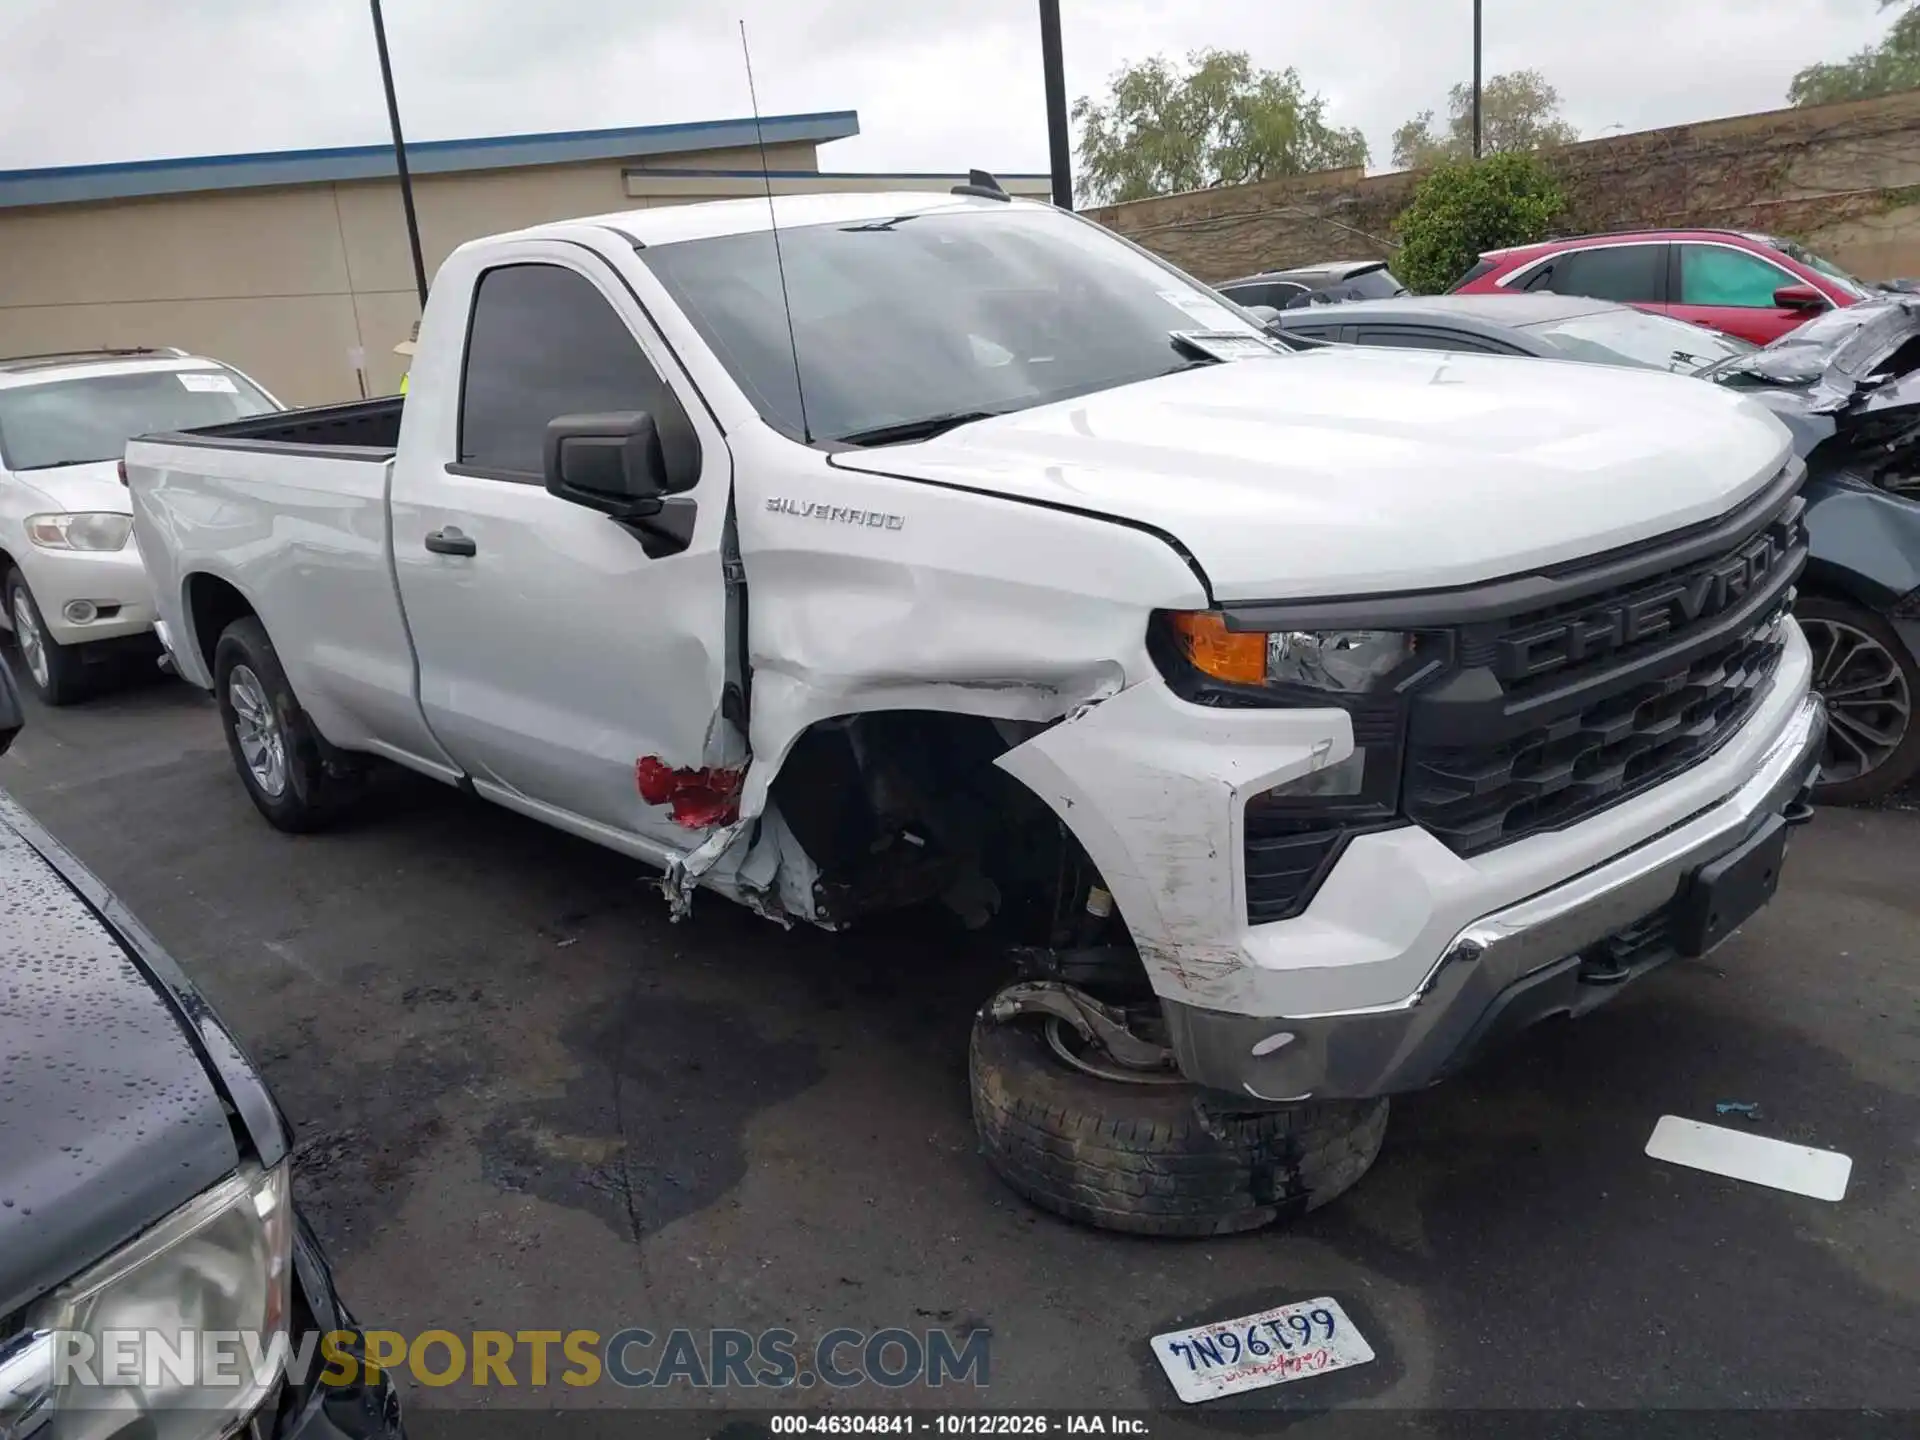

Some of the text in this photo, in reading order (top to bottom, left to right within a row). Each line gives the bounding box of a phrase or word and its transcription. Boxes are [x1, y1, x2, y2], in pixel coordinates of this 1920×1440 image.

[766, 496, 906, 530] SILVERADO
[1169, 1308, 1336, 1371] 66196N4
[1224, 1349, 1329, 1383] California
